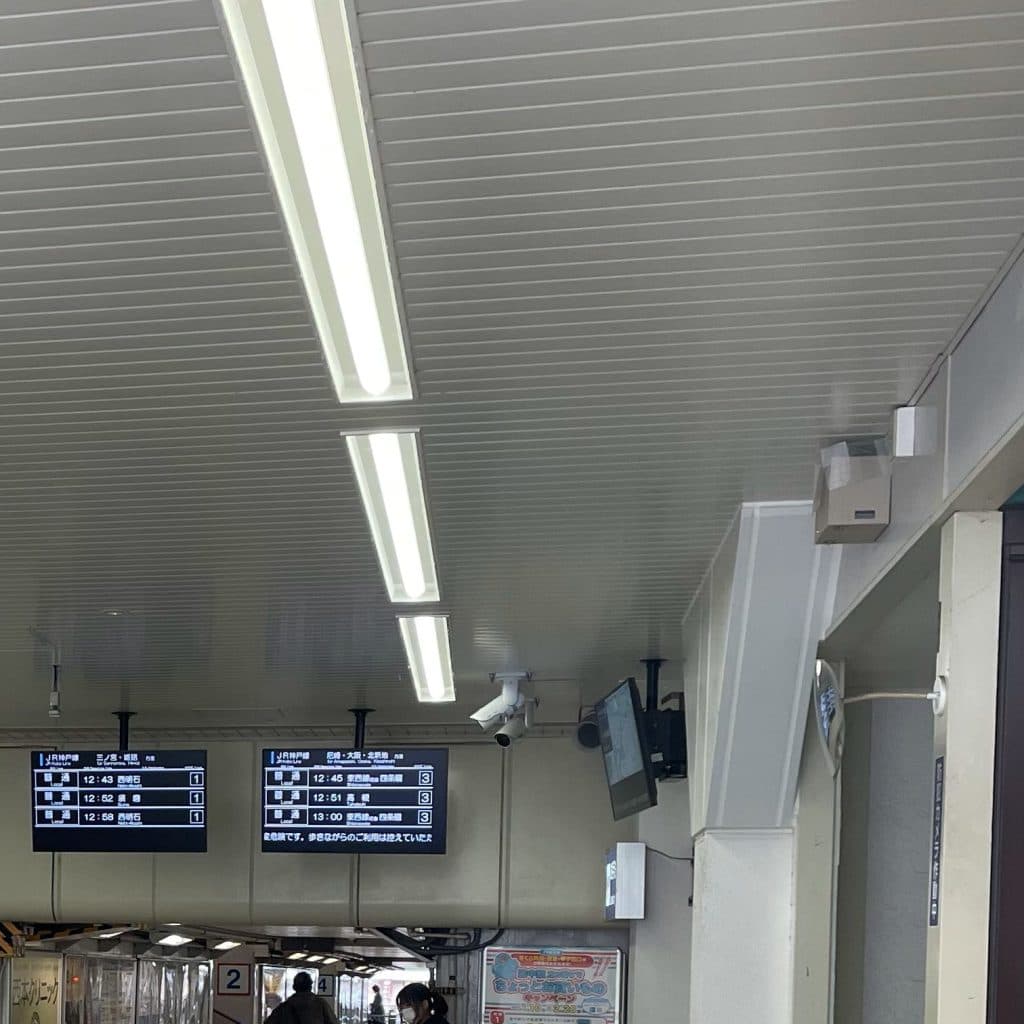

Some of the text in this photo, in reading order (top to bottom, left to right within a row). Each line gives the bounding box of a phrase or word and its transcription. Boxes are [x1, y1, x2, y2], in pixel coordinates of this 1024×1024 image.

[84, 776, 114, 784] 12:43
[193, 776, 200, 784] 1
[314, 774, 343, 782] 12:45
[422, 774, 430, 782] 3
[84, 794, 114, 802] 12:52
[314, 794, 342, 802] 12:51
[422, 794, 429, 802] 3
[421, 813, 428, 822] 3
[226, 969, 240, 989] 2
[318, 978, 328, 992] 4
